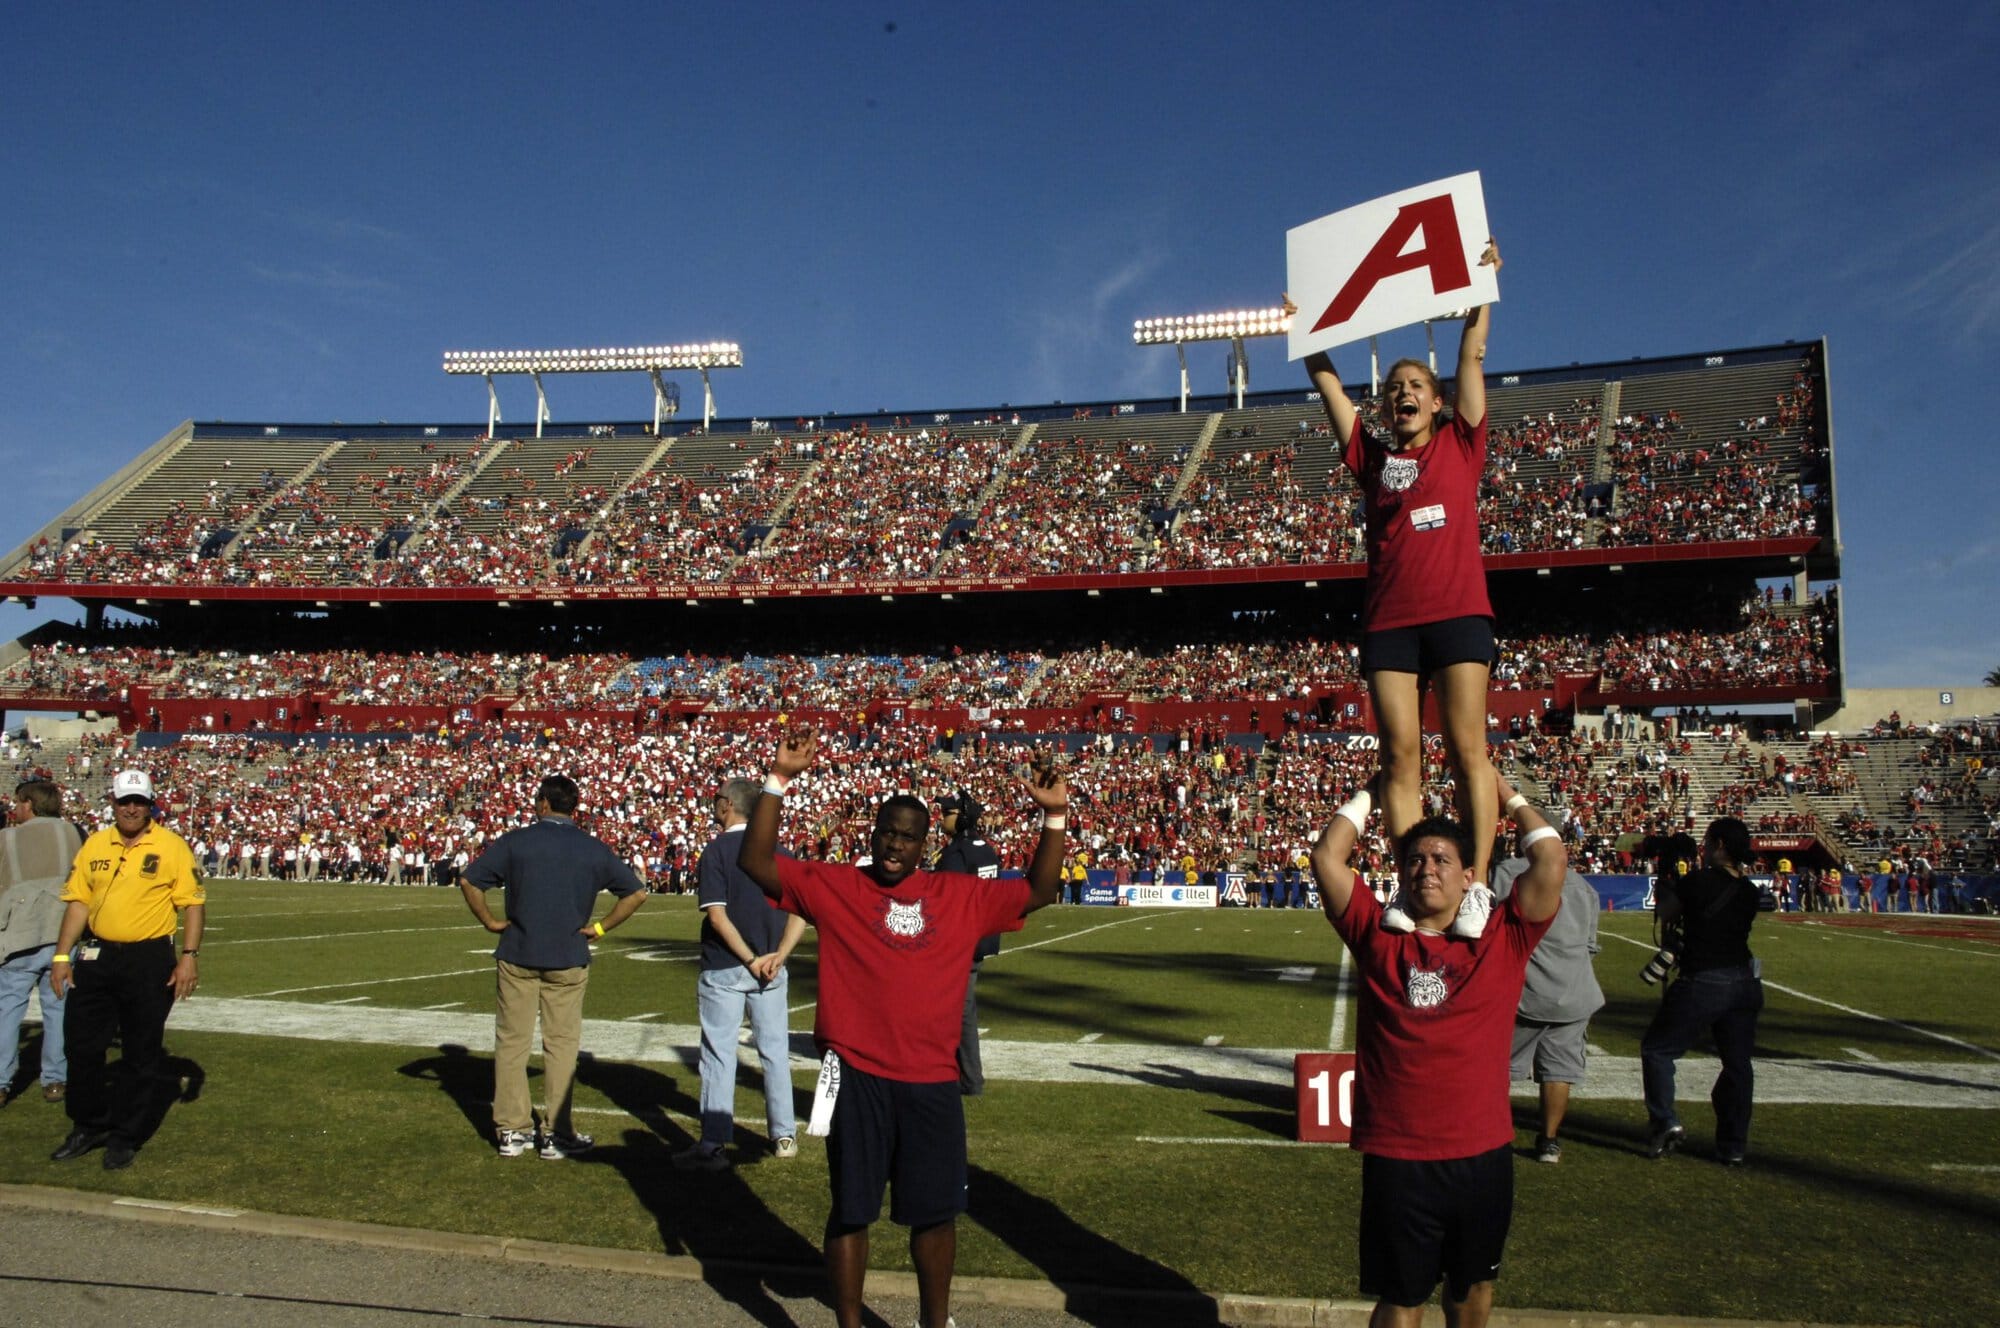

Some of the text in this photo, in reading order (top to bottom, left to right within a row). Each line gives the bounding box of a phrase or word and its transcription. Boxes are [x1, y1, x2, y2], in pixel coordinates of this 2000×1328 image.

[1310, 193, 1471, 334] A
[1705, 356, 1724, 366] 209
[1942, 693, 1951, 703] 8
[1089, 888, 1113, 896] Game
[1084, 894, 1117, 903] Sponsor
